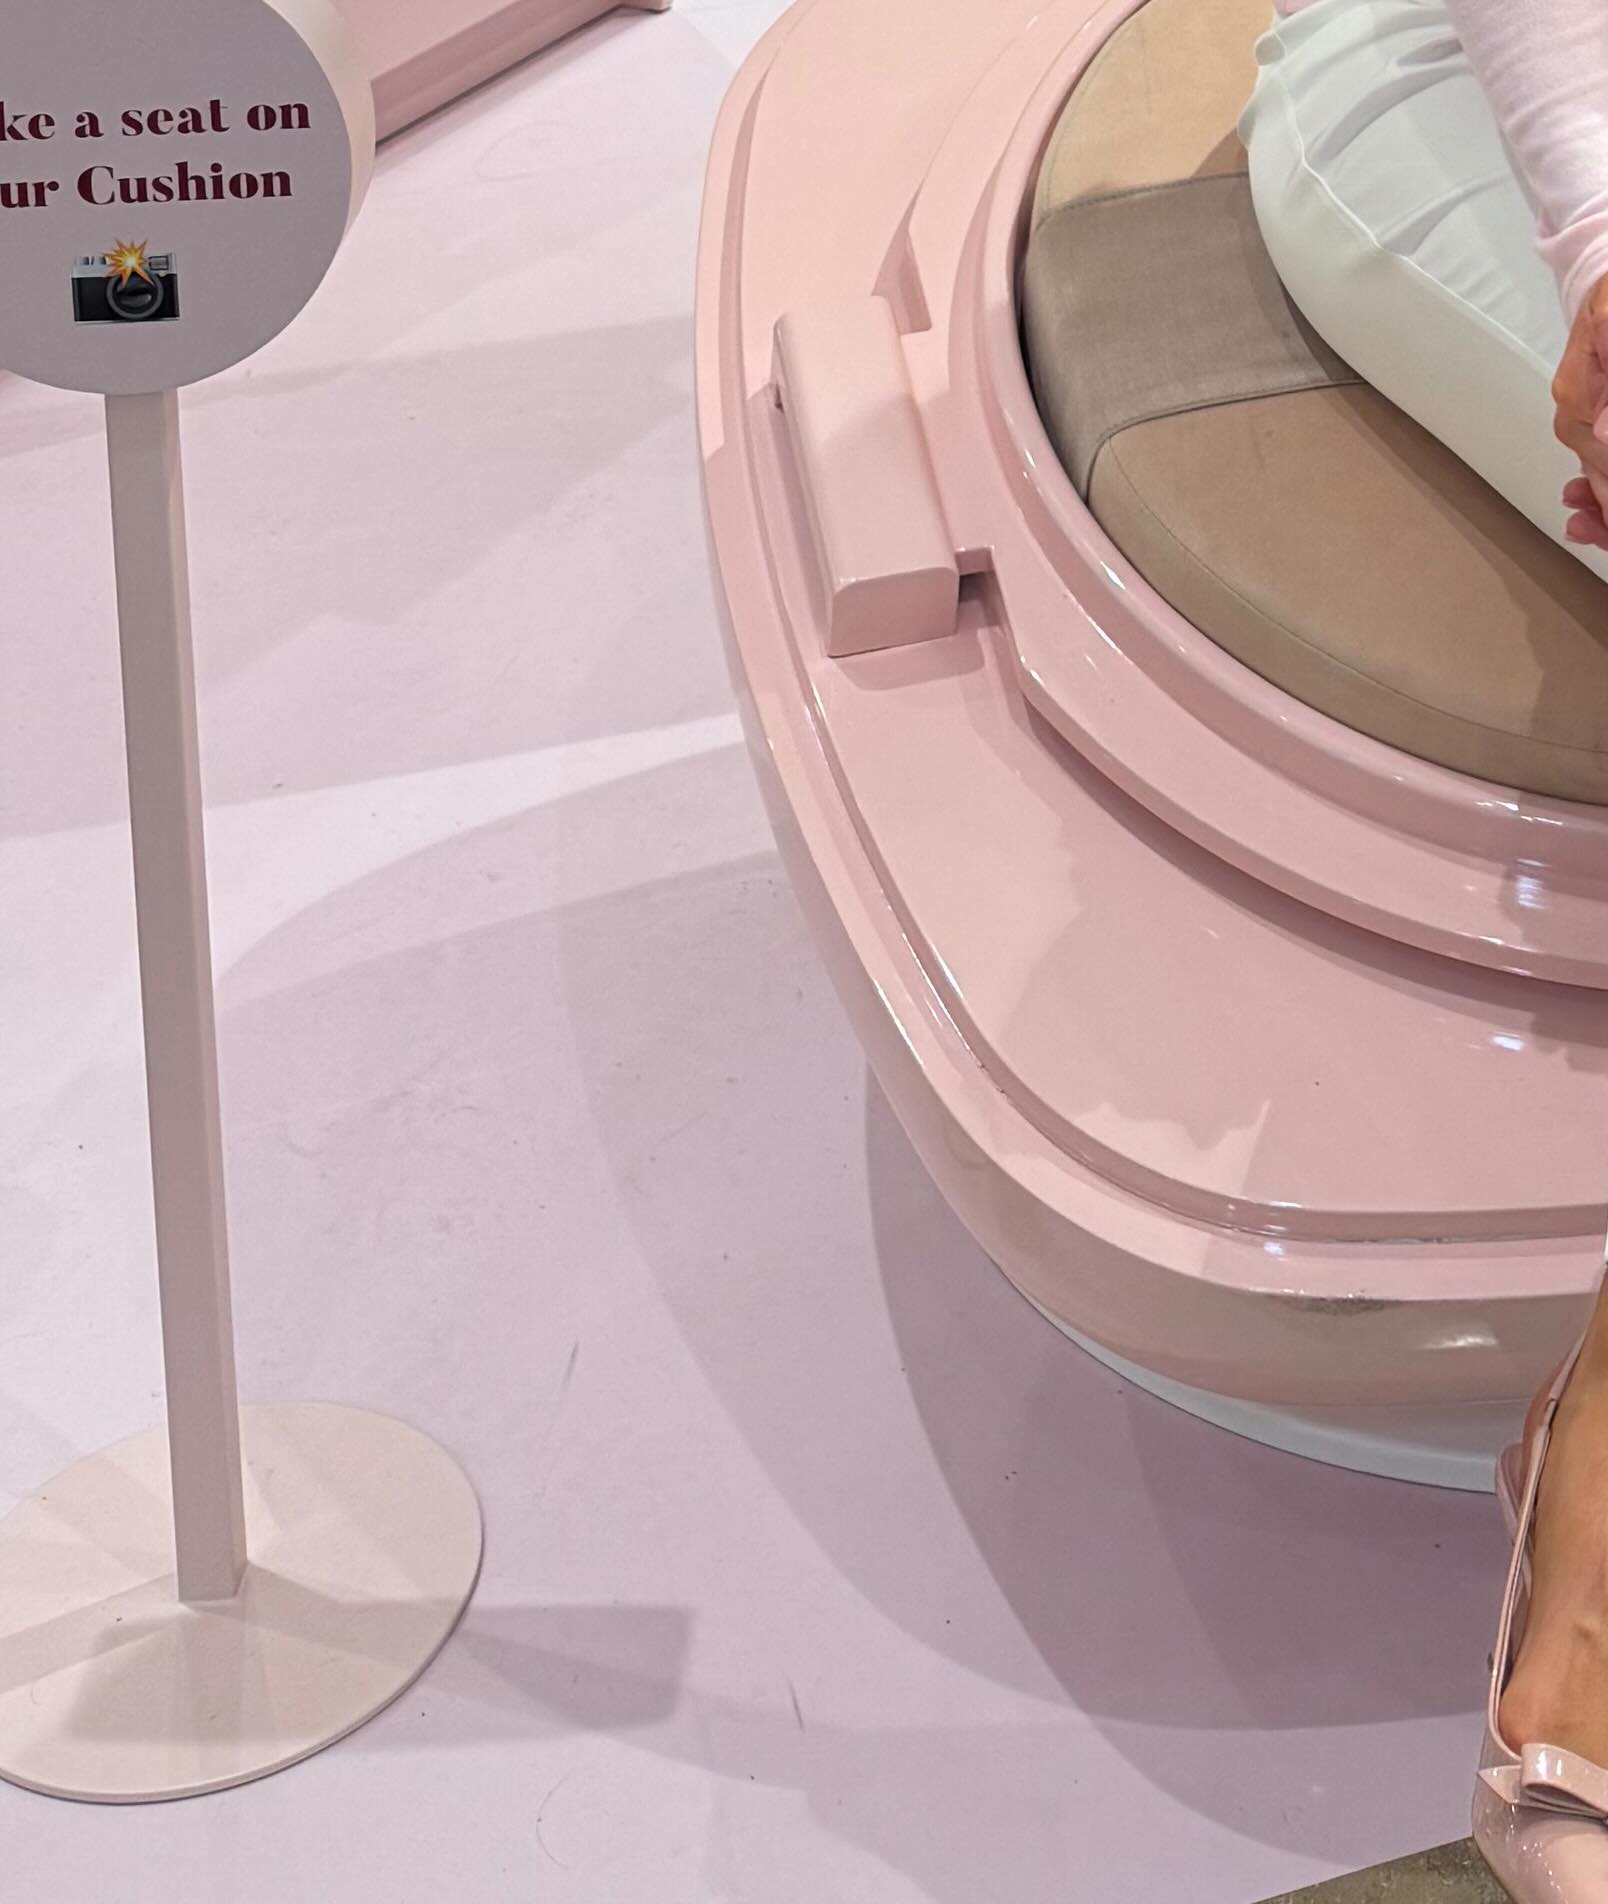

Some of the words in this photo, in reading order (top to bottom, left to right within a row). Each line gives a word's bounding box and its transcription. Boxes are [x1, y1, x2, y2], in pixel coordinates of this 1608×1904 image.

[74, 111, 104, 139] a
[120, 98, 230, 137] seat
[246, 102, 311, 132] on
[77, 160, 294, 206] Cushion
